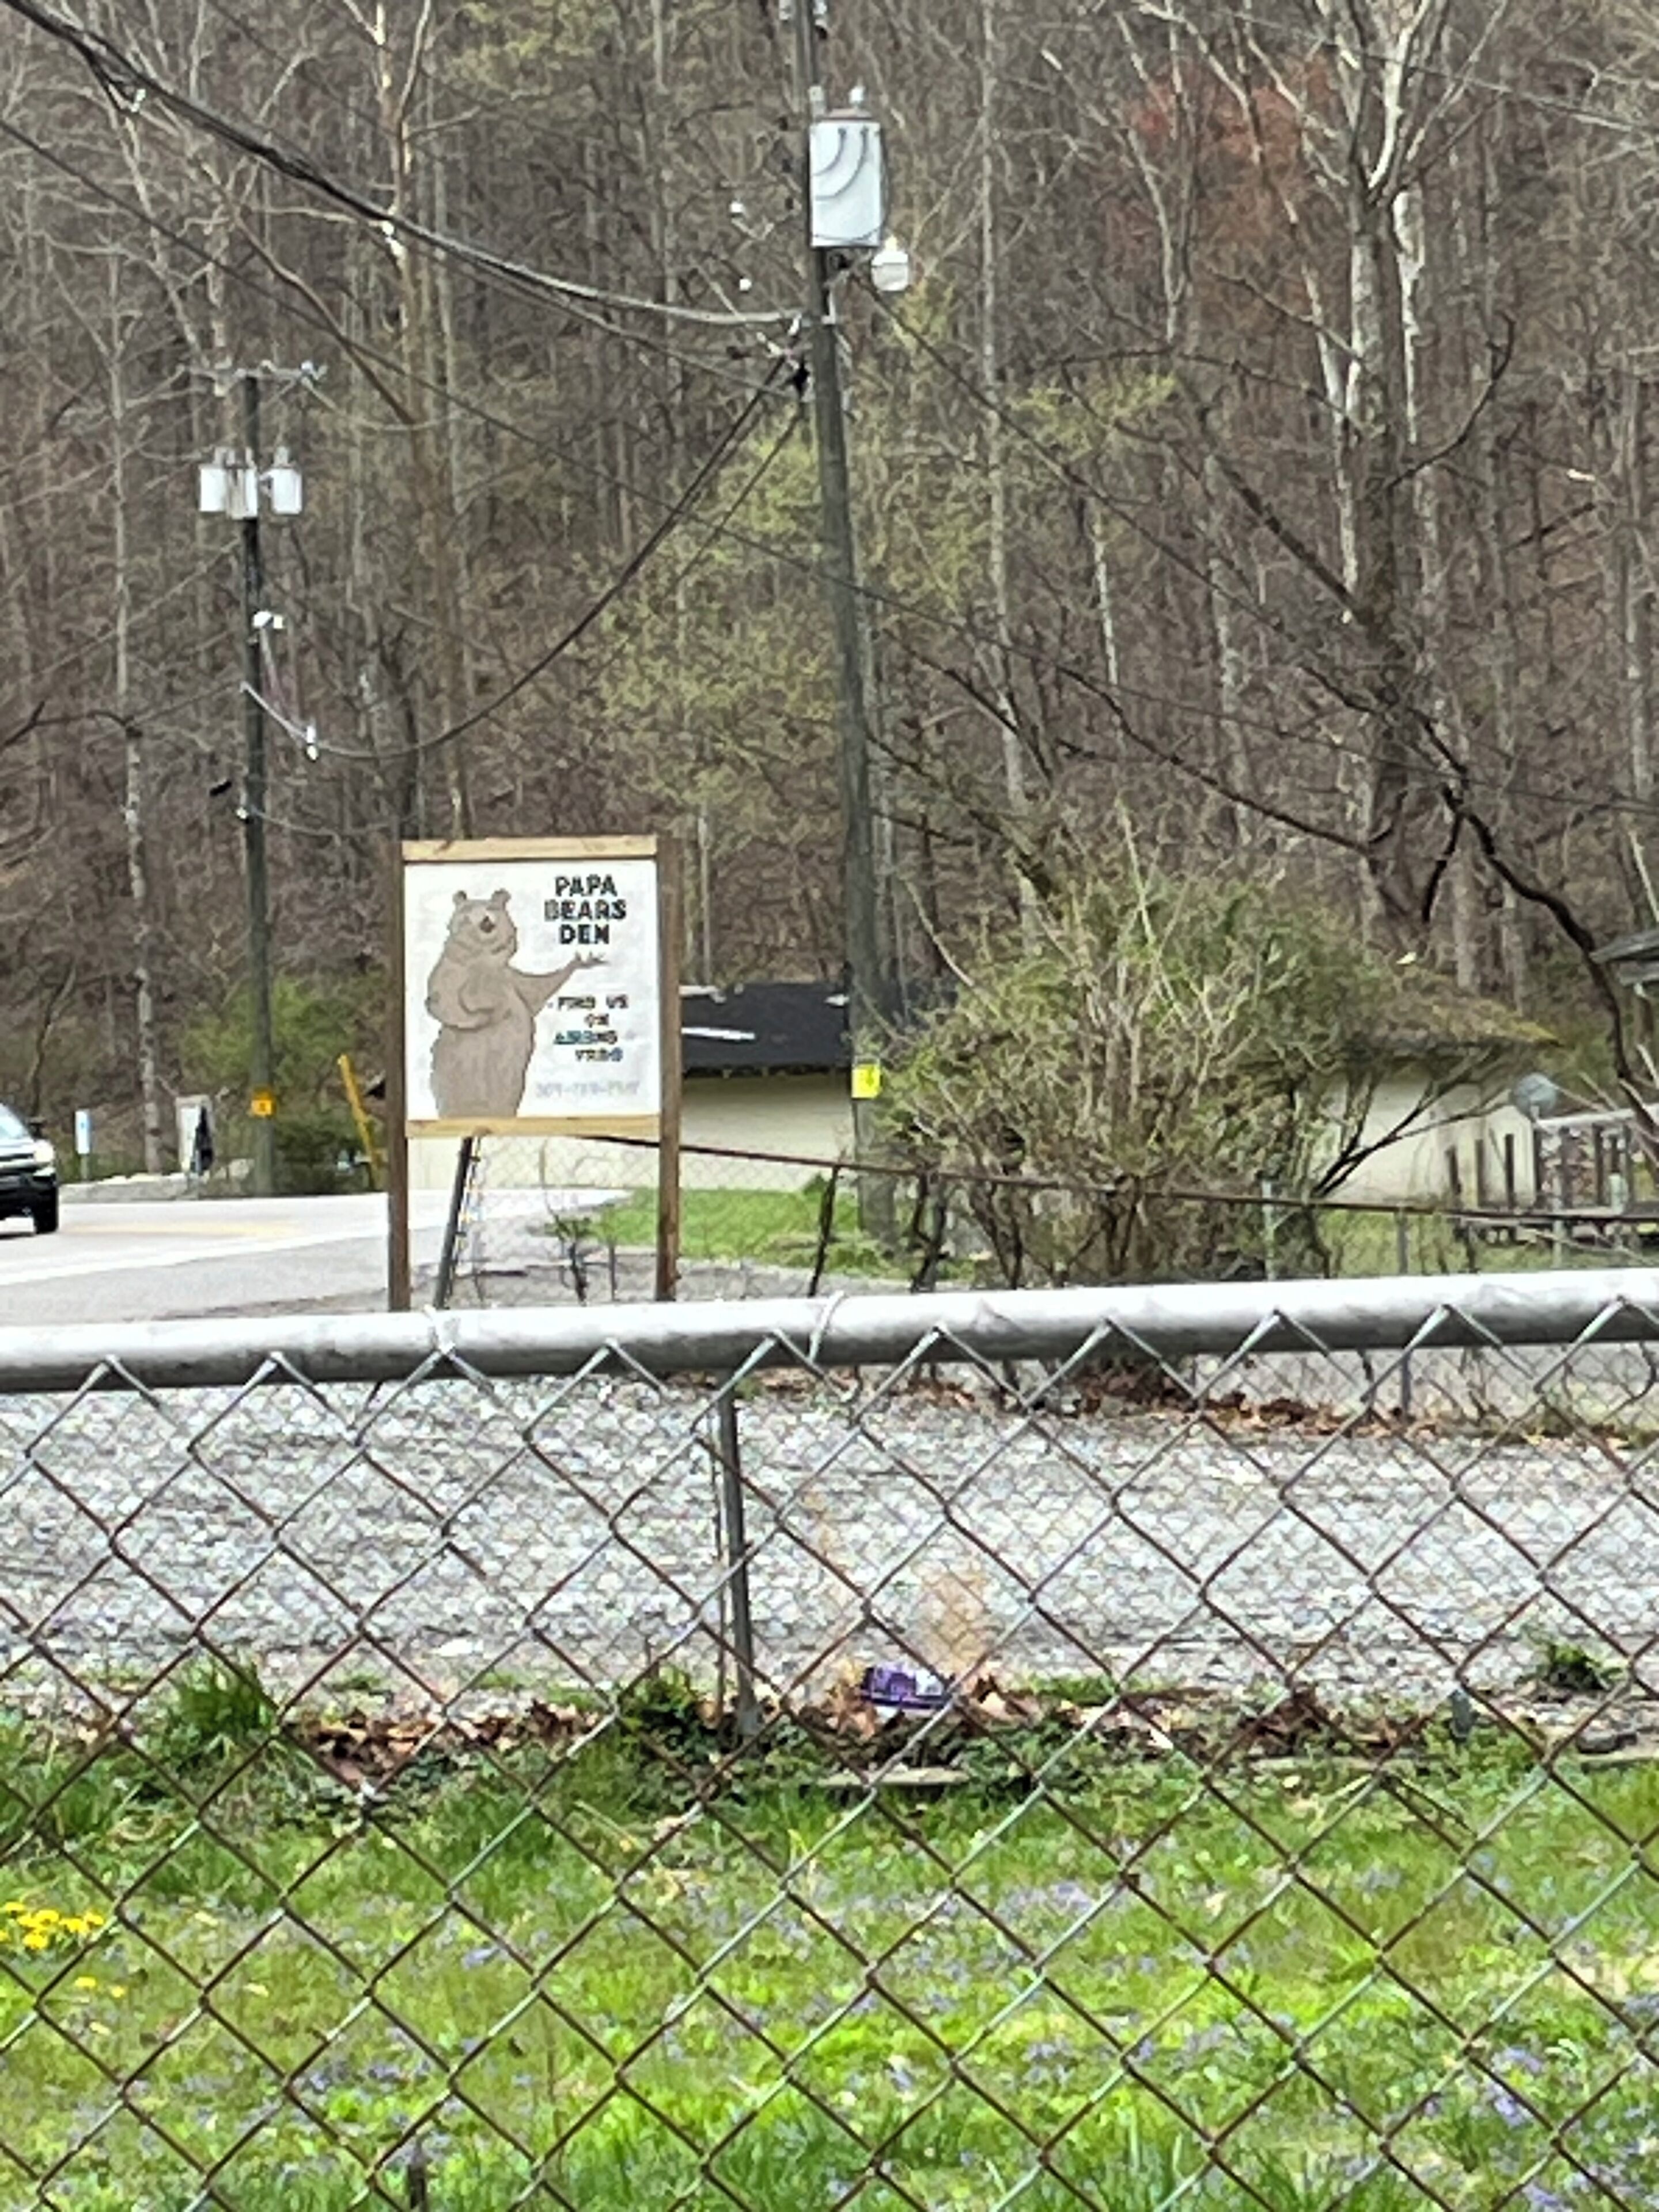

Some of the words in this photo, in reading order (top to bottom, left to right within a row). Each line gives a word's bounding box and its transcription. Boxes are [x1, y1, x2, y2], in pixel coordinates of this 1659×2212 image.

[555, 874, 618, 897] PAPA
[544, 899, 627, 922] BEARS
[559, 923, 610, 945] DEN
